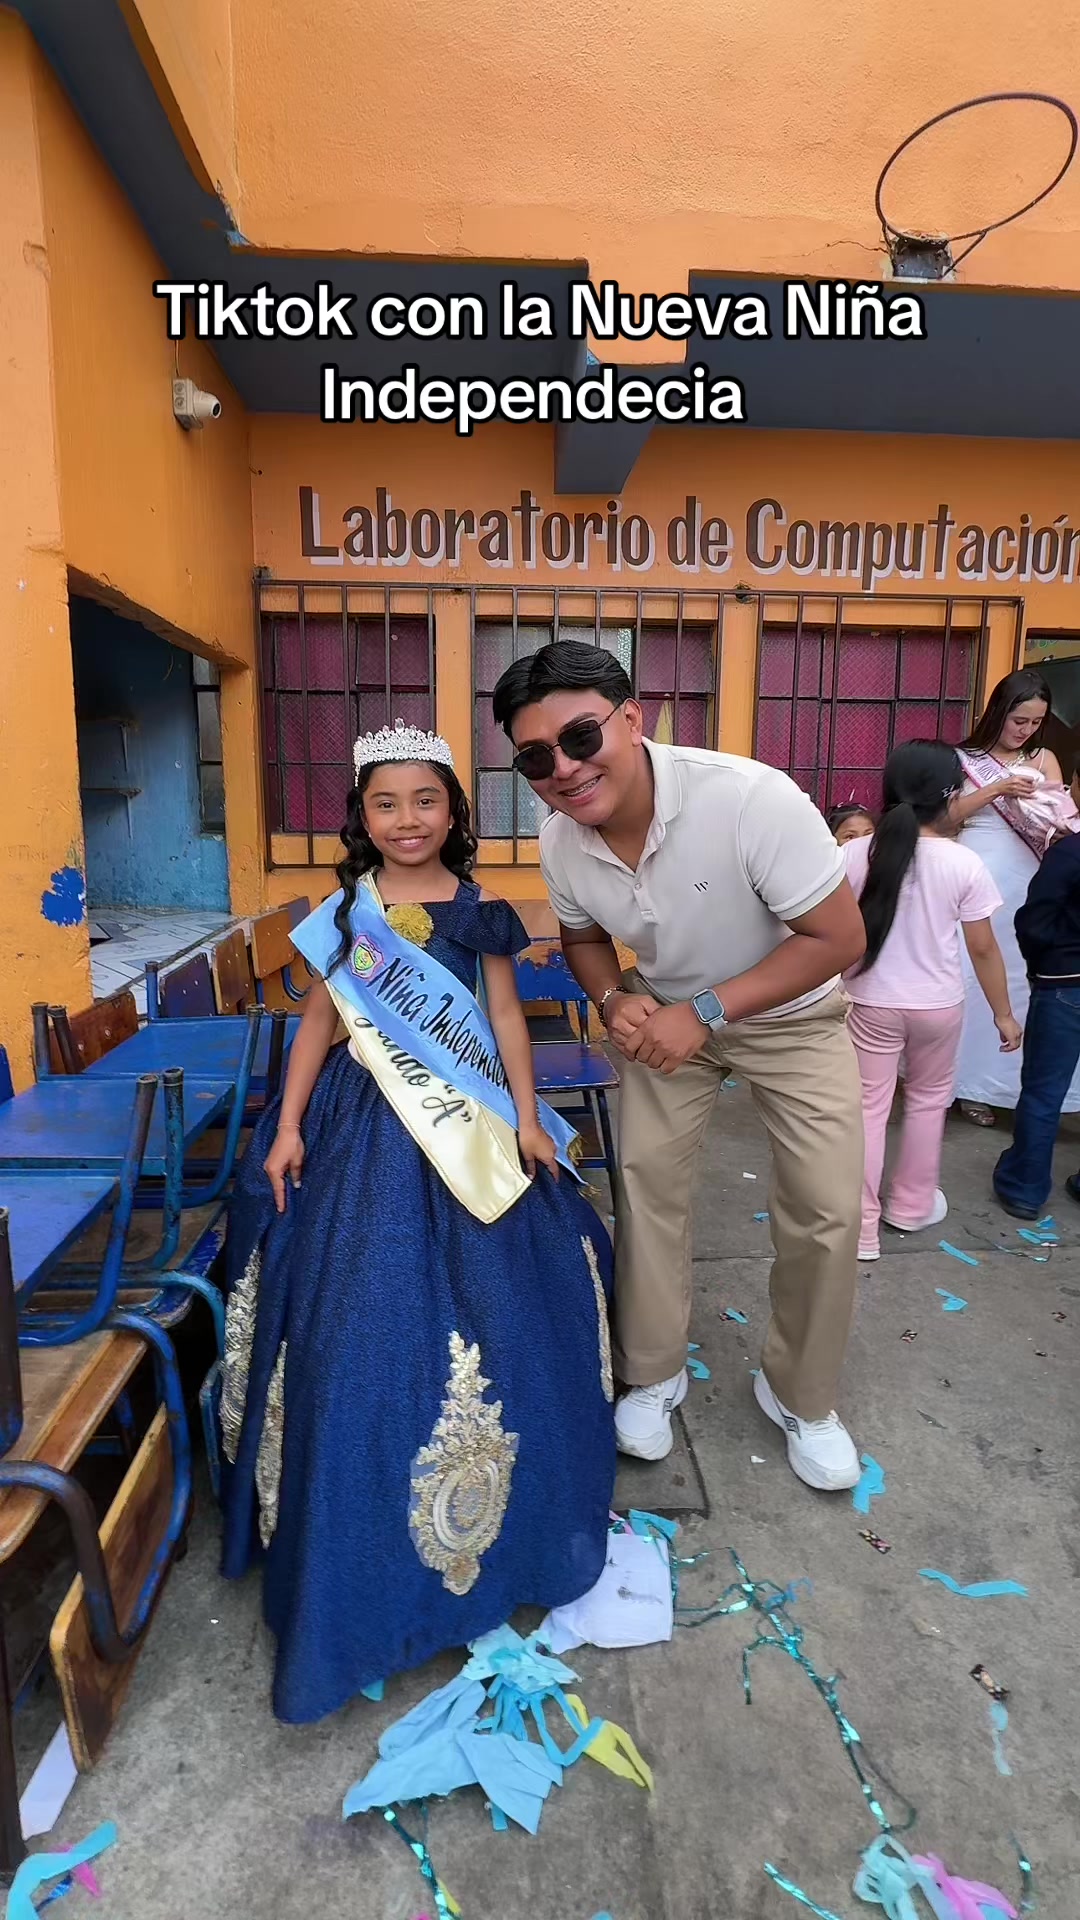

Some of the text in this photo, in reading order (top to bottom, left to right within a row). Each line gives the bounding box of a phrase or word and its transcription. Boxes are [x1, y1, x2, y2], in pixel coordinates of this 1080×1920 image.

[299, 485, 1080, 597] Laboratorio de Computación
[366, 957, 428, 1022] Niña
